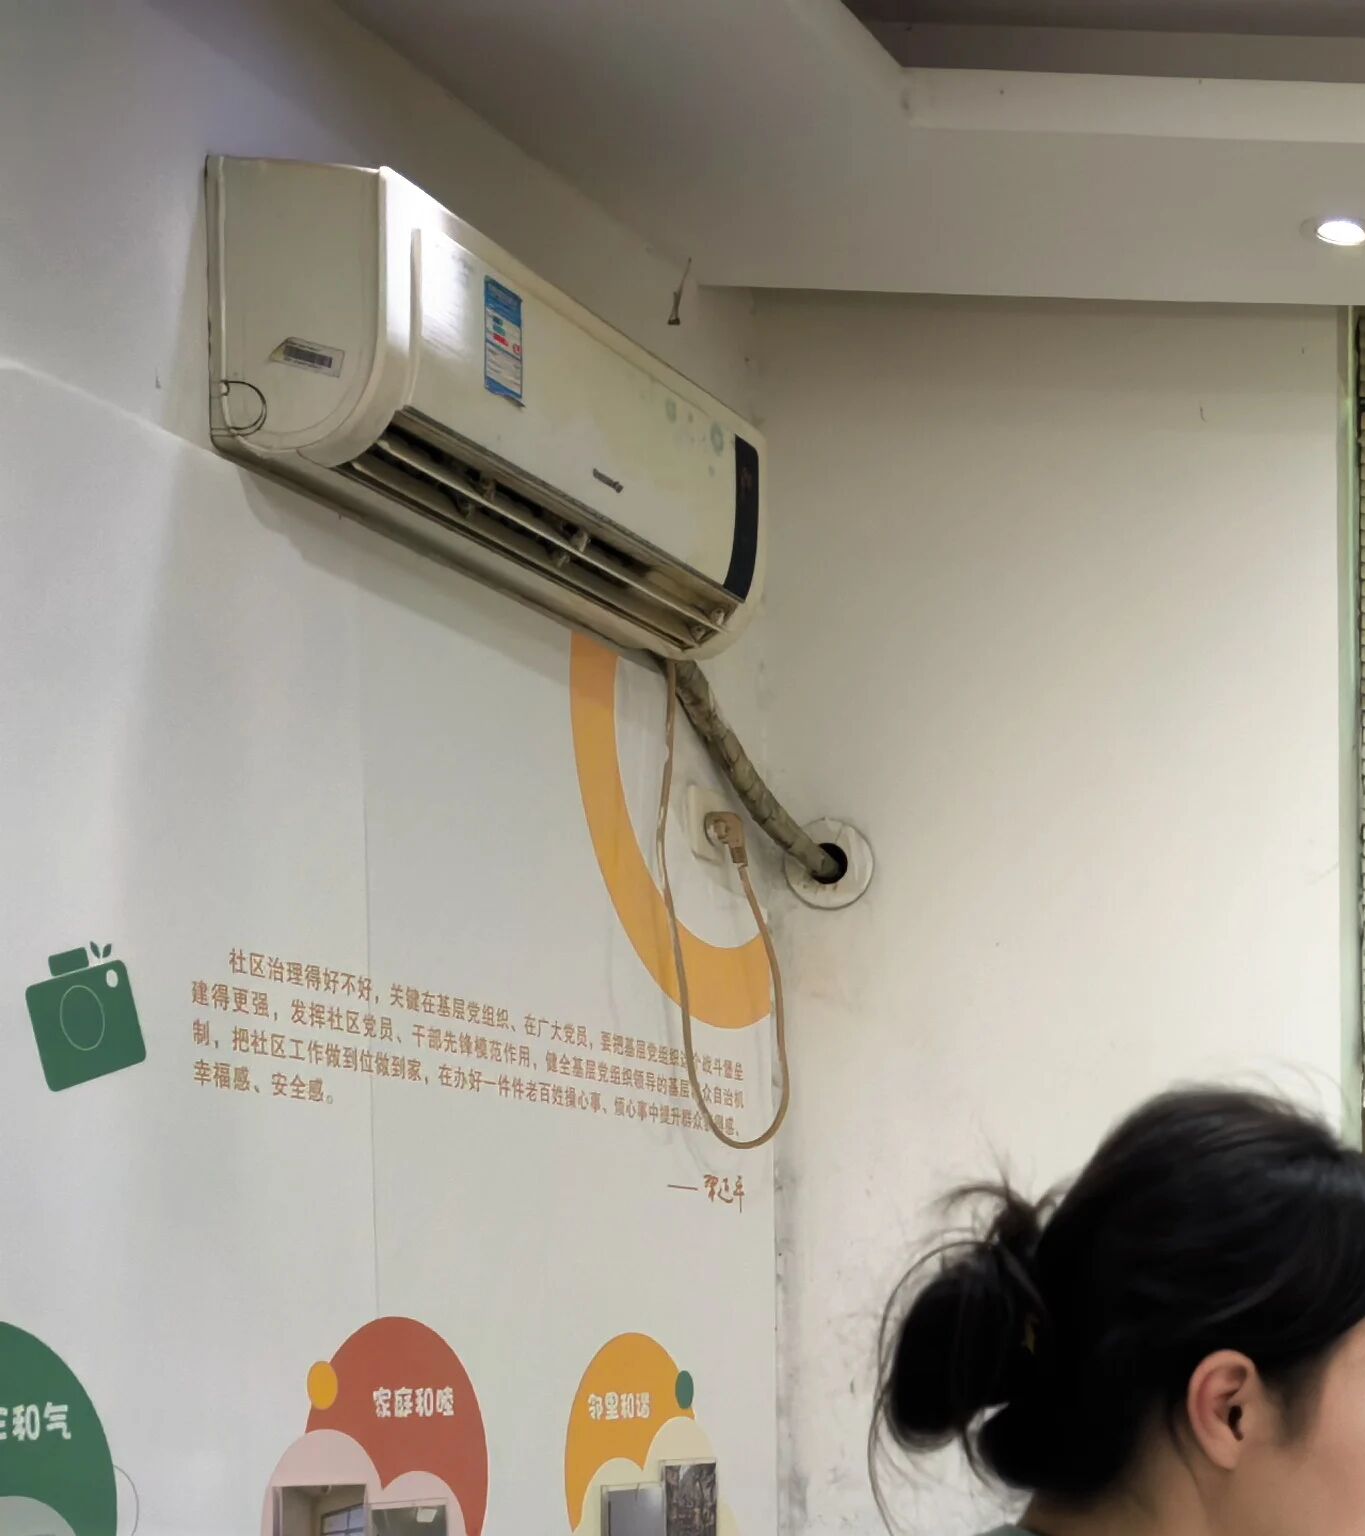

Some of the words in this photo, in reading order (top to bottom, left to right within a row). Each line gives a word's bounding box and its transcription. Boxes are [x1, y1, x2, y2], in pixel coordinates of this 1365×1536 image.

[193, 1058, 334, 1105] 幸福感、安全感。
[372, 1386, 455, 1418] 家庭和睦
[588, 1391, 650, 1421] 邻里和谐
